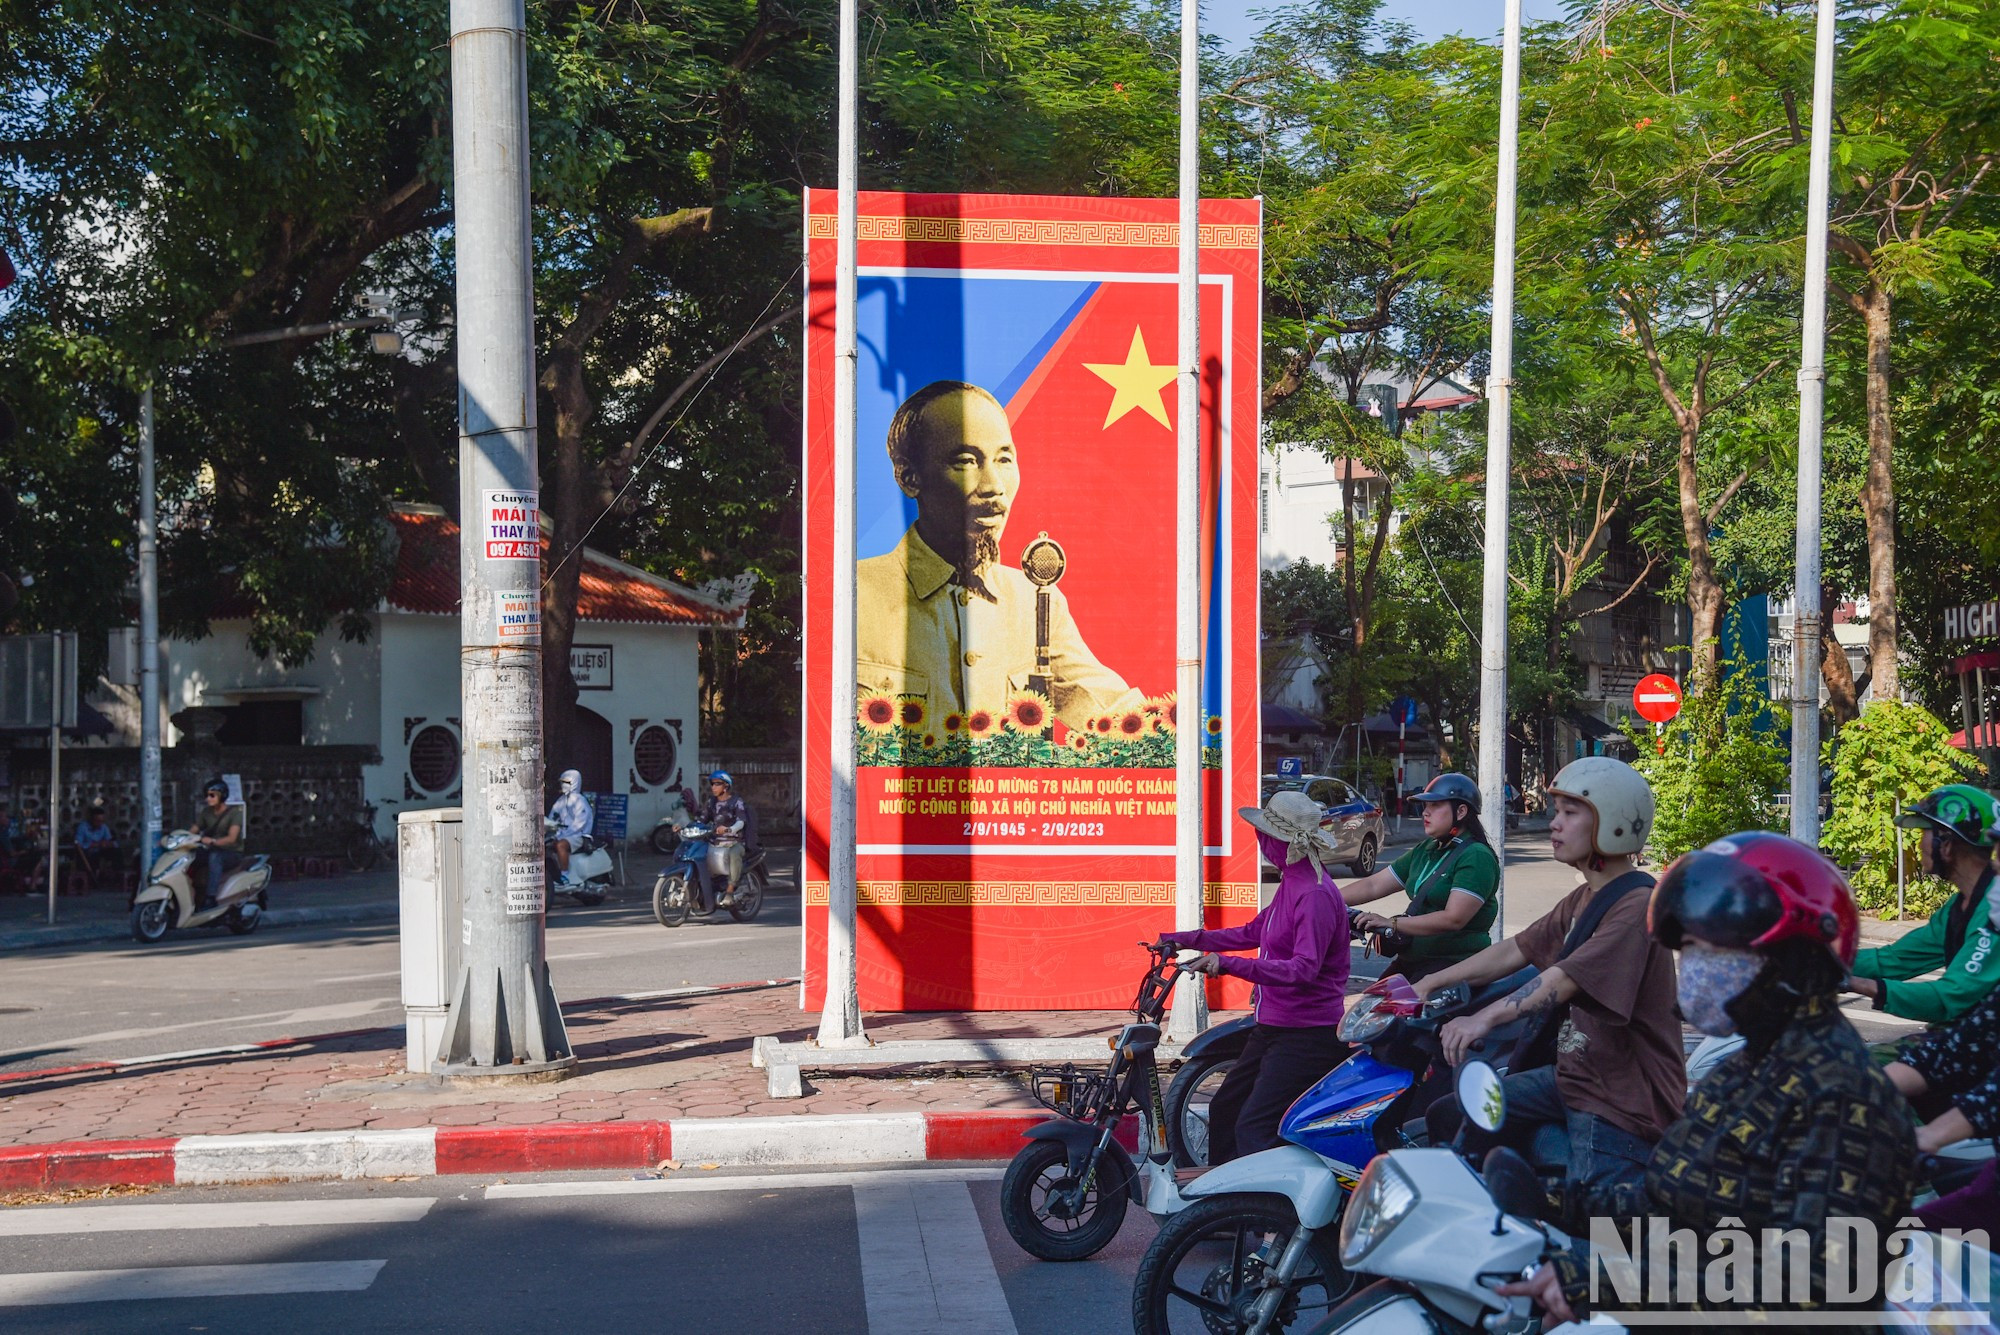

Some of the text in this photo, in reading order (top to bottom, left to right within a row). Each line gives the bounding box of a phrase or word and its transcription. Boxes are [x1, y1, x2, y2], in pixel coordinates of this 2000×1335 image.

[492, 506, 526, 521] MÁI
[491, 525, 523, 538] THAY
[502, 614, 526, 624] THAY
[1944, 602, 2000, 640] HIGH
[884, 776, 923, 796] NHIỆT
[928, 776, 954, 796] LIỆT
[958, 776, 994, 793] CHÀO
[998, 776, 1039, 794] MỪNG
[1042, 780, 1058, 794] 78
[1061, 777, 1093, 794] NĂM
[1097, 775, 1133, 795] QUỐC
[879, 796, 1176, 818] NƯỚC CỘNG HÒA XÃ HỘI CHỦ NGHĨA VIỆT NAM
[963, 822, 1025, 836] 2/9/1945
[1042, 822, 1104, 837] 2/9/2023
